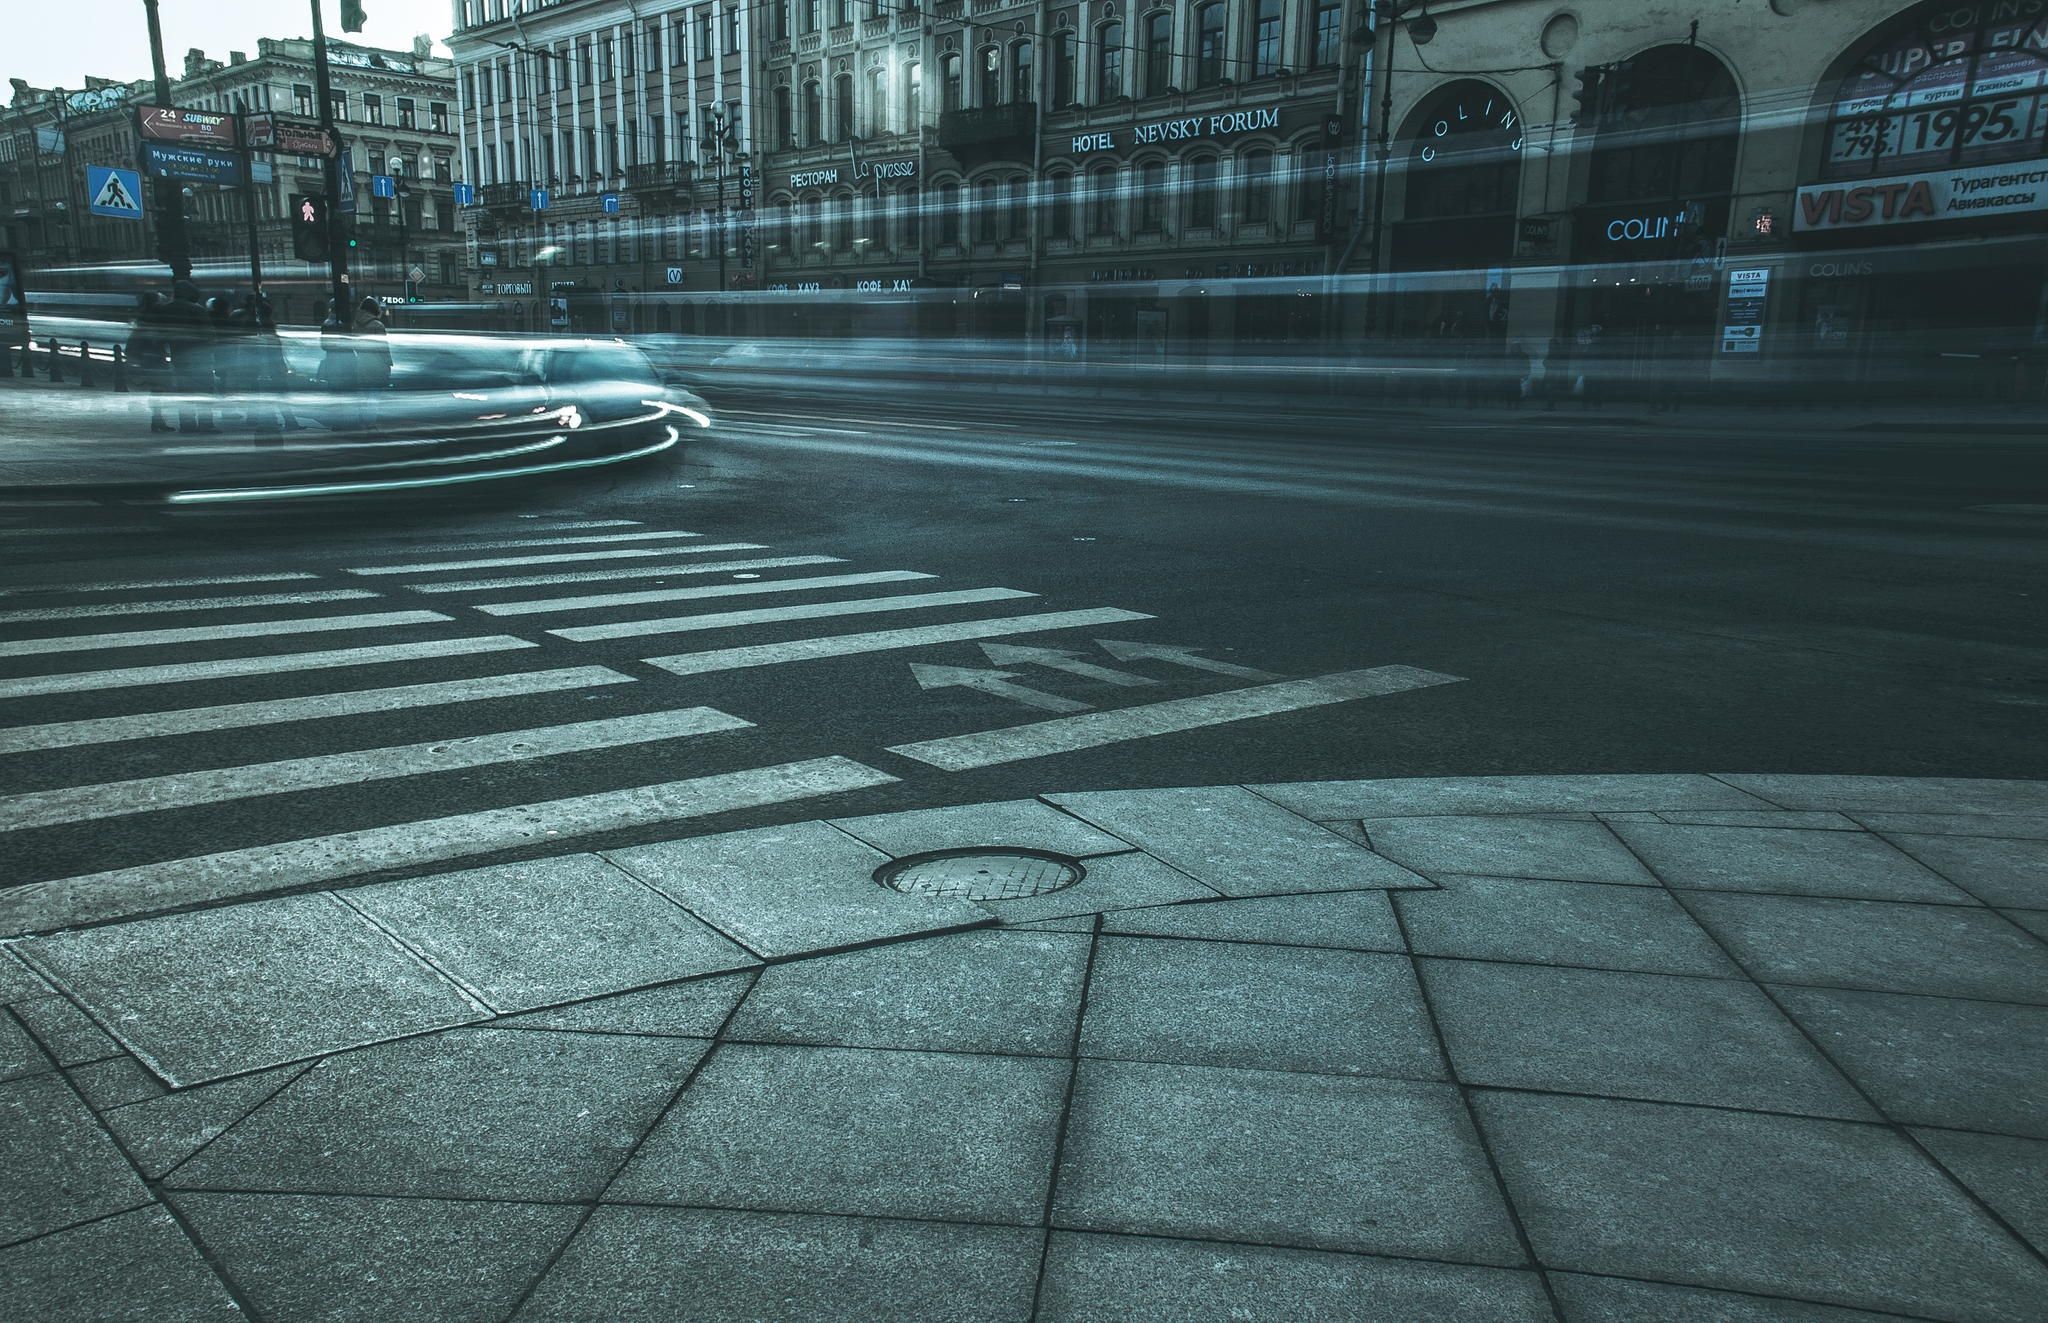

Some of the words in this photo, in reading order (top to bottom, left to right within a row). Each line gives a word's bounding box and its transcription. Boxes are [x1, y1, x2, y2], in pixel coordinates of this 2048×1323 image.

[160, 109, 176, 119] 24
[1071, 131, 1115, 153] HOTEL
[1134, 117, 1204, 145] NEVSKY
[1209, 107, 1280, 136] FORUM
[152, 150, 202, 164] Мужские
[207, 158, 233, 168] руки
[790, 169, 838, 188] РЕСТОРАН
[1799, 180, 1937, 227] VISTA
[1946, 191, 2037, 212] Авиакассы
[1736, 272, 1761, 280] VISTA
[496, 280, 532, 295] ТОРГОВЫЙ
[856, 281, 882, 293] КОФЕ
